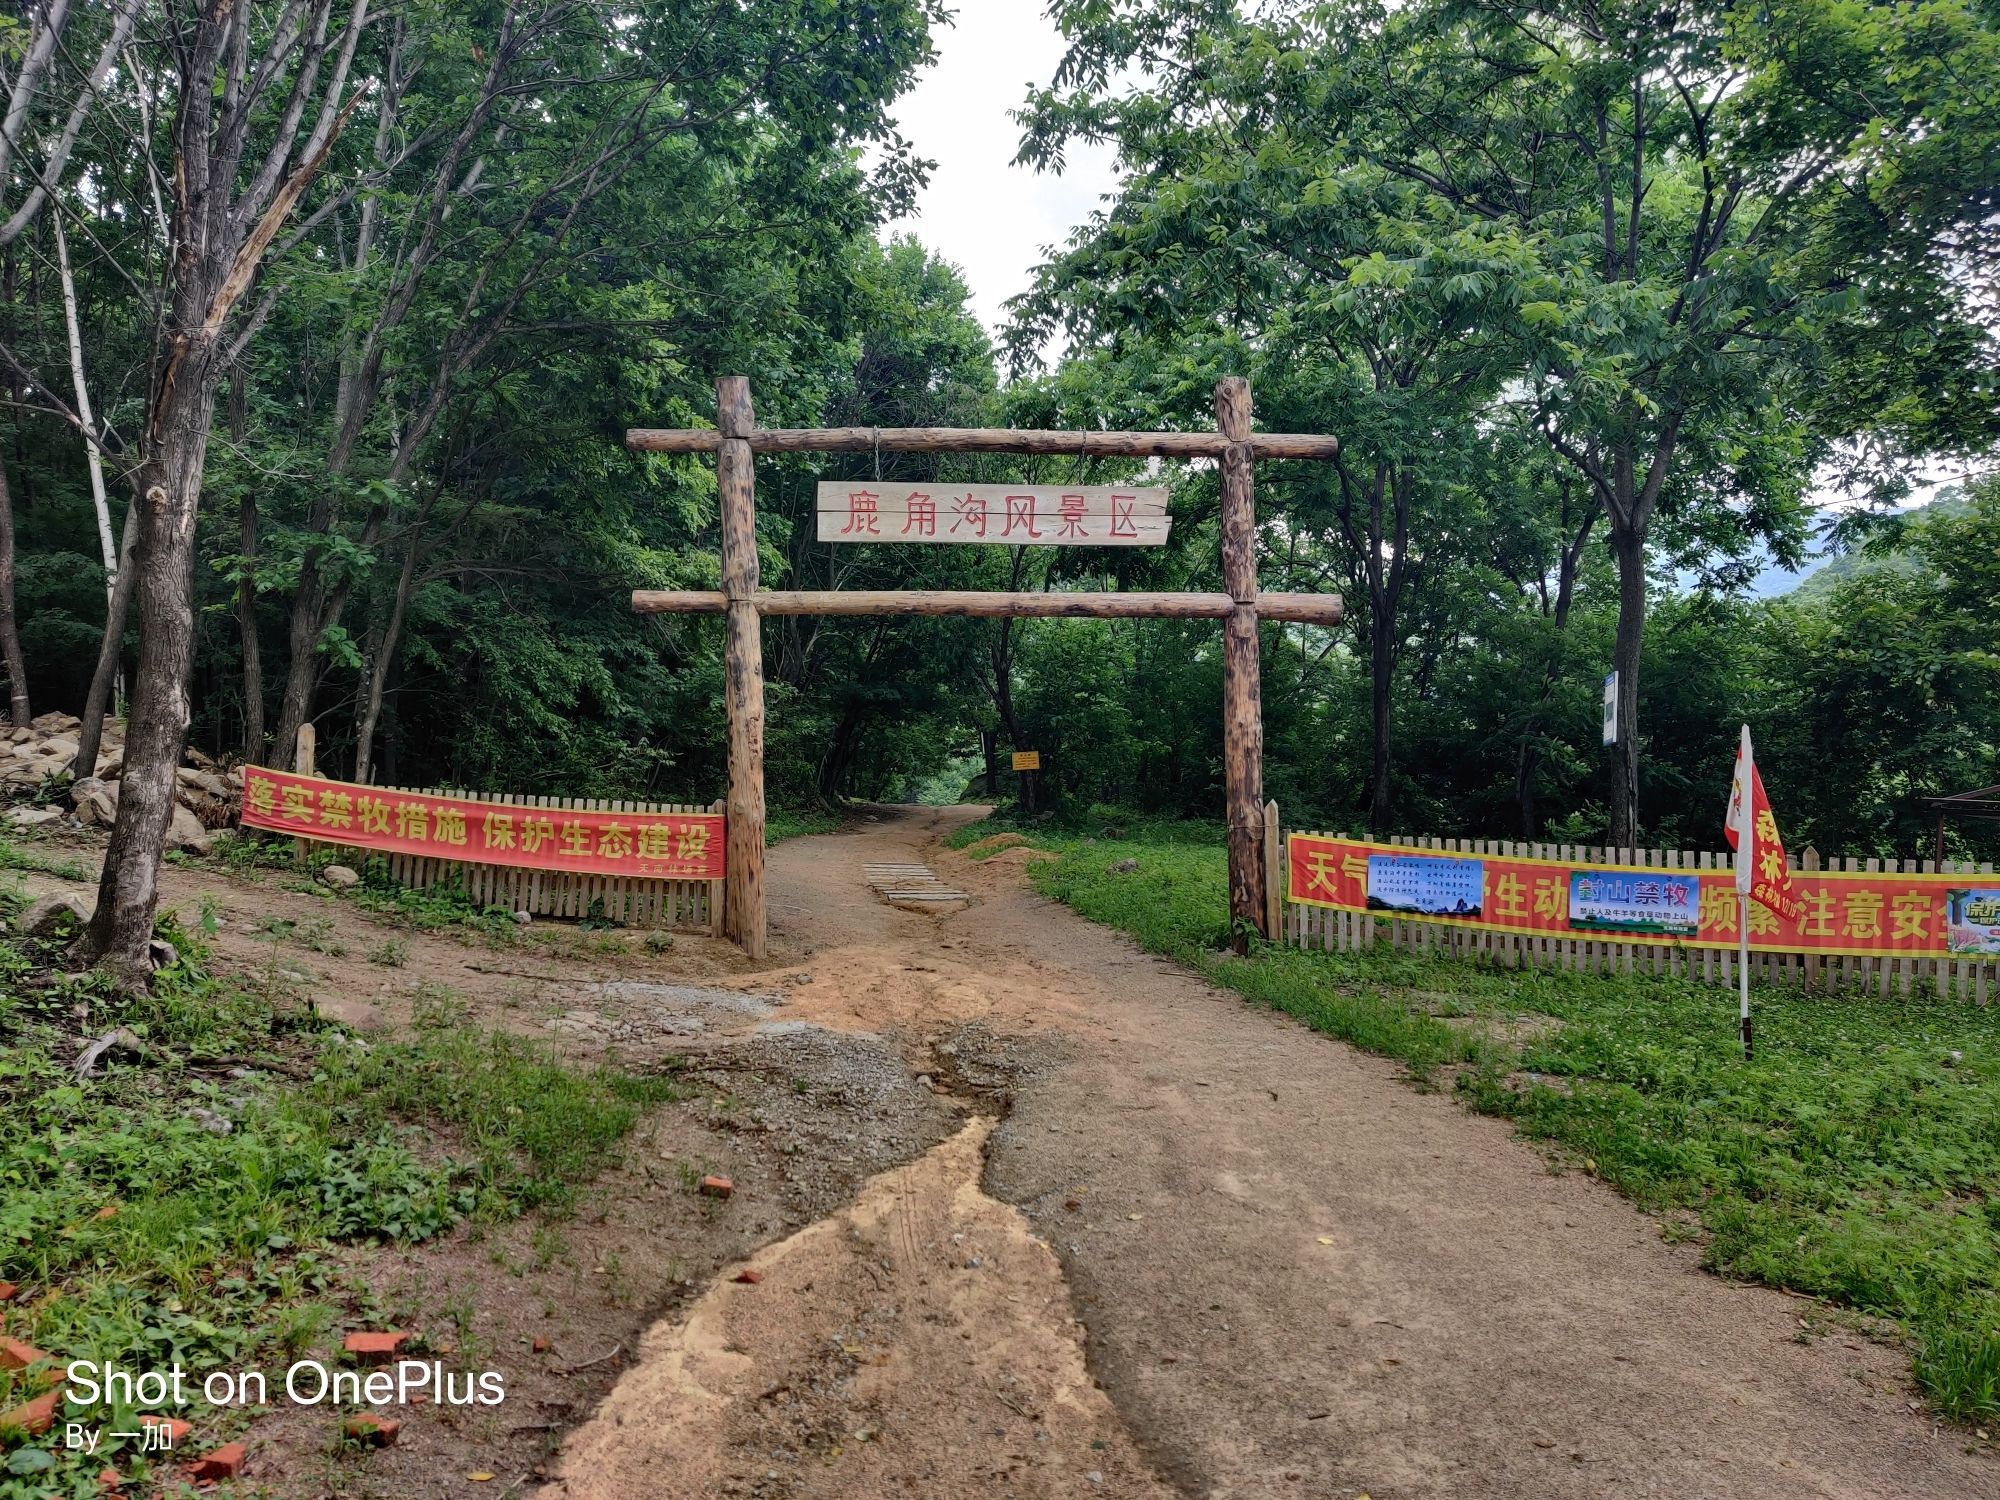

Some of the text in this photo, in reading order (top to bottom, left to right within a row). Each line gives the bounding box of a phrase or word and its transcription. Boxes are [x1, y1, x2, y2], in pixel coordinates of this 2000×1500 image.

[840, 490, 1138, 539] 鹿角沟风景区
[248, 775, 711, 860] 落实禁牧措施 保护生态建设
[1483, 870, 1568, 921] 生动
[1578, 879, 1690, 906] 封山禁牧
